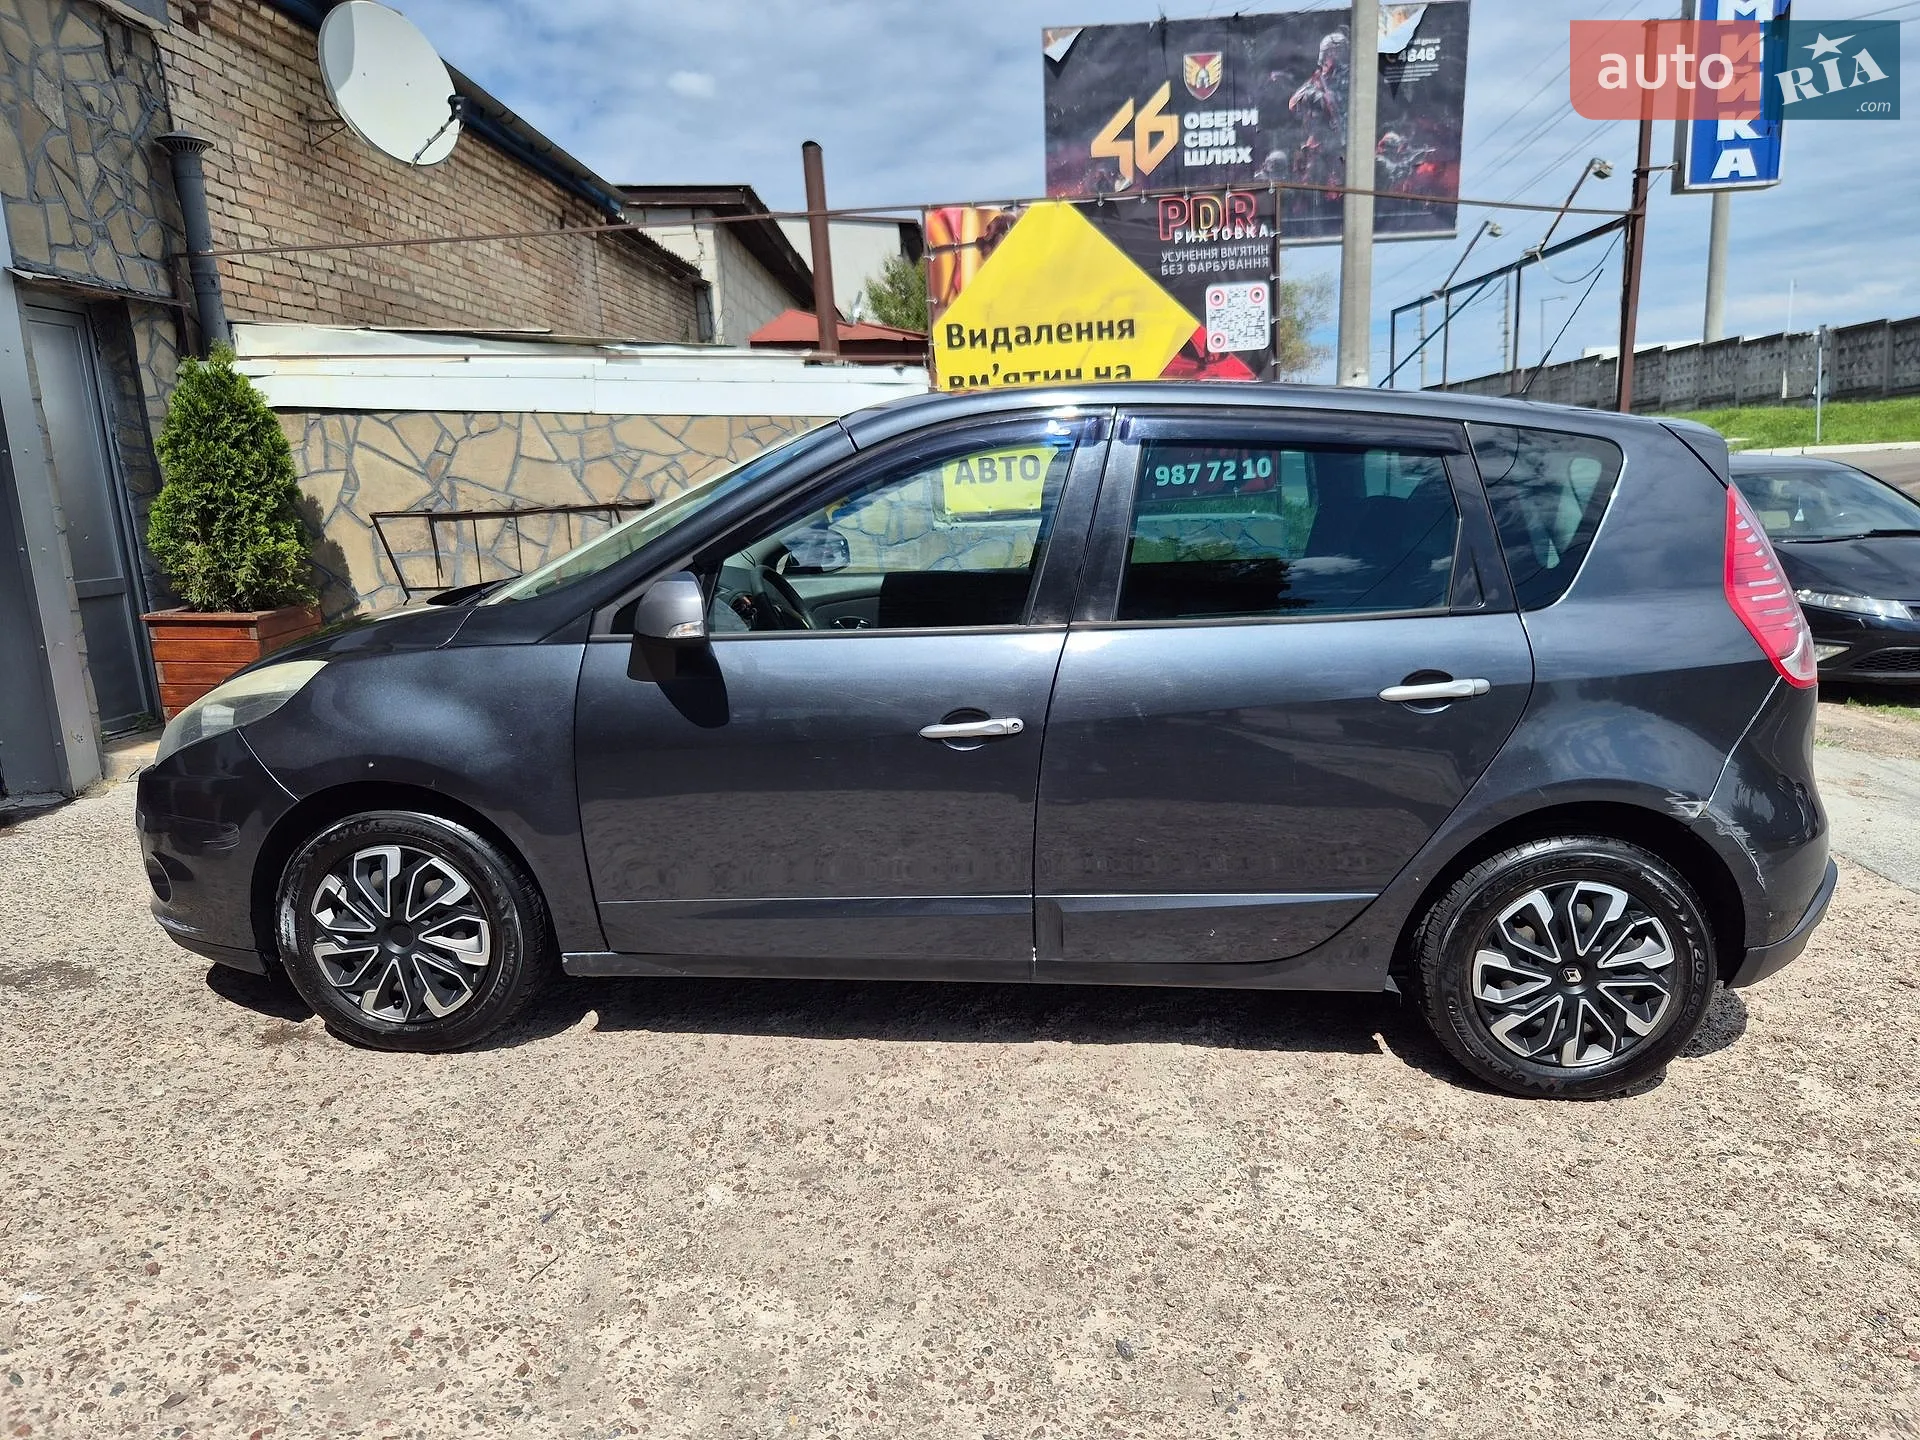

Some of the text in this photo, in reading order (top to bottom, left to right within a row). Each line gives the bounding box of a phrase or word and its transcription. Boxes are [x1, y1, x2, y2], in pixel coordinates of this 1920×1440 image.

[1183, 108, 1259, 130] ОБЕРИ
[1091, 80, 1179, 187] 46
[1183, 127, 1237, 148] СВІЙ
[1184, 147, 1253, 167] ШЛЯХ
[1158, 192, 1257, 241] PDR
[1174, 223, 1269, 244] РИХТОВКА
[1161, 244, 1269, 263] УСУНЕННЯ ВМ'ЯТИН
[1161, 257, 1269, 276] БЕЗ ФАРБУВАННЯ
[946, 318, 1135, 353] Видалення
[954, 454, 1041, 485] АВТО
[1155, 457, 1271, 486] 987 72 10
